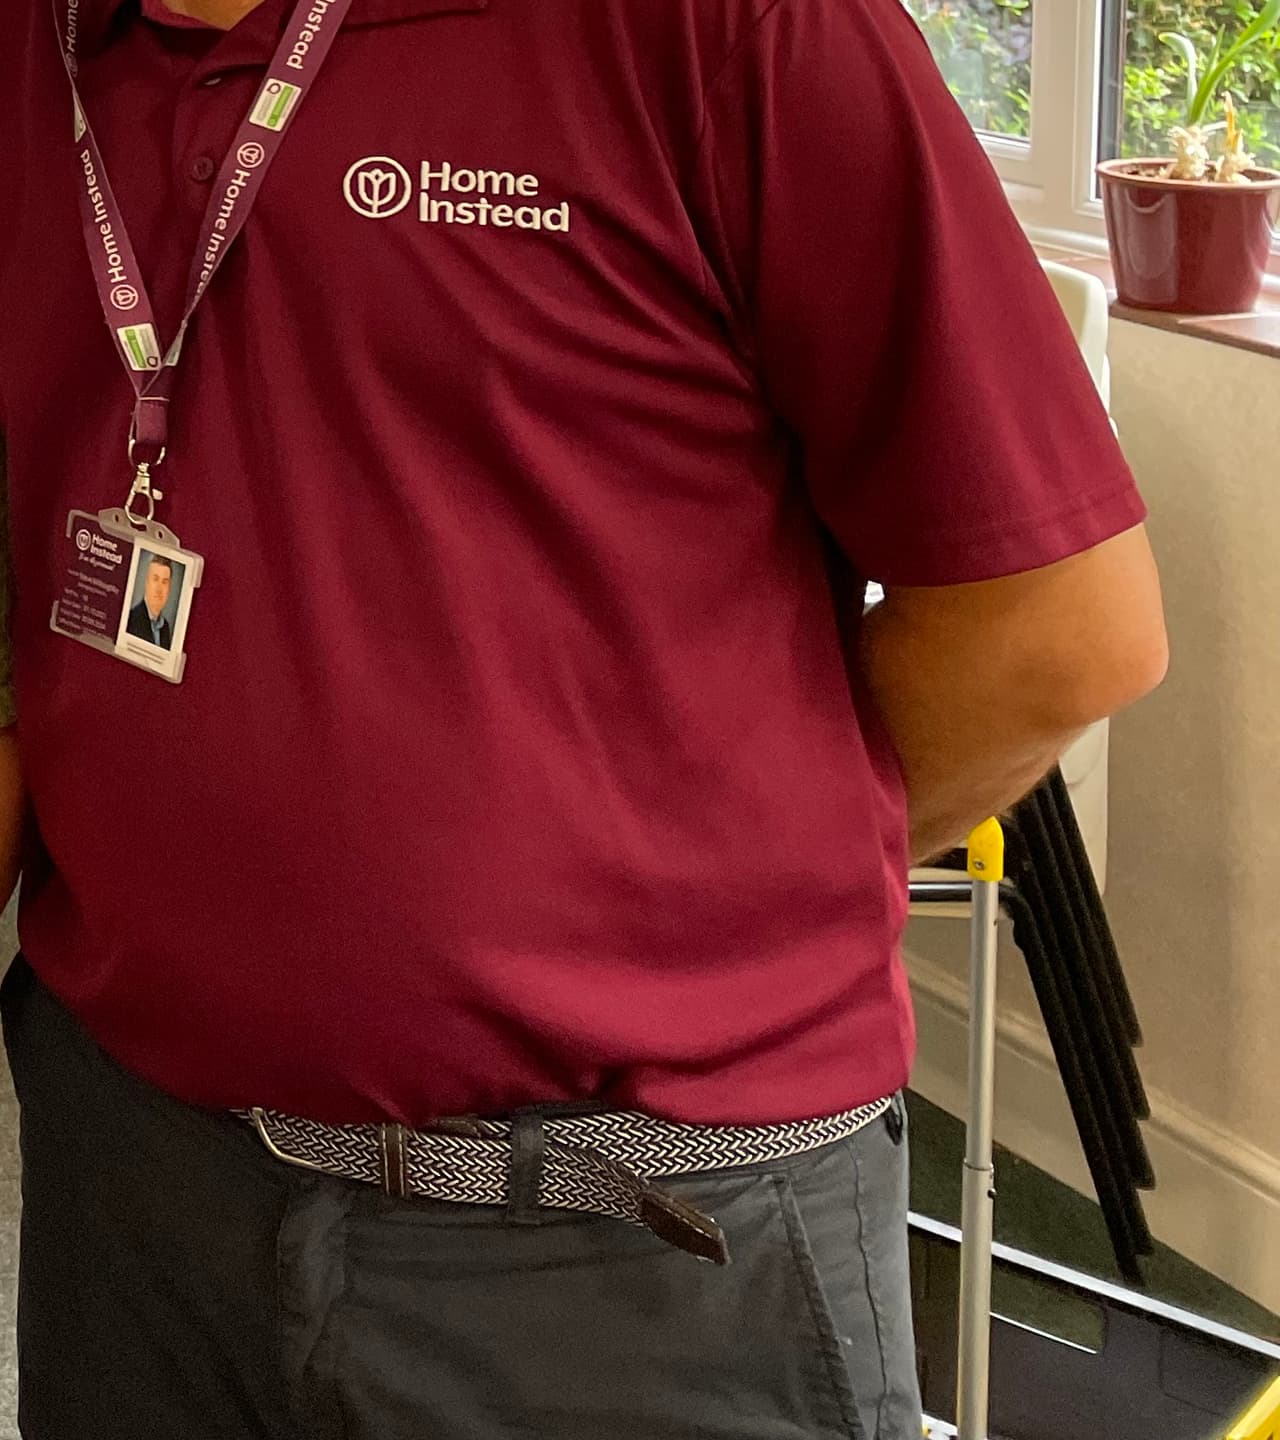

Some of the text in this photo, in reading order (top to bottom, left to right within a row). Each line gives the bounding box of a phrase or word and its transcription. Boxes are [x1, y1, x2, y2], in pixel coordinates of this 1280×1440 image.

[214, 169, 251, 230] Home
[420, 160, 539, 196] Home
[80, 149, 127, 283] Home Instead
[419, 191, 570, 232] Instead
